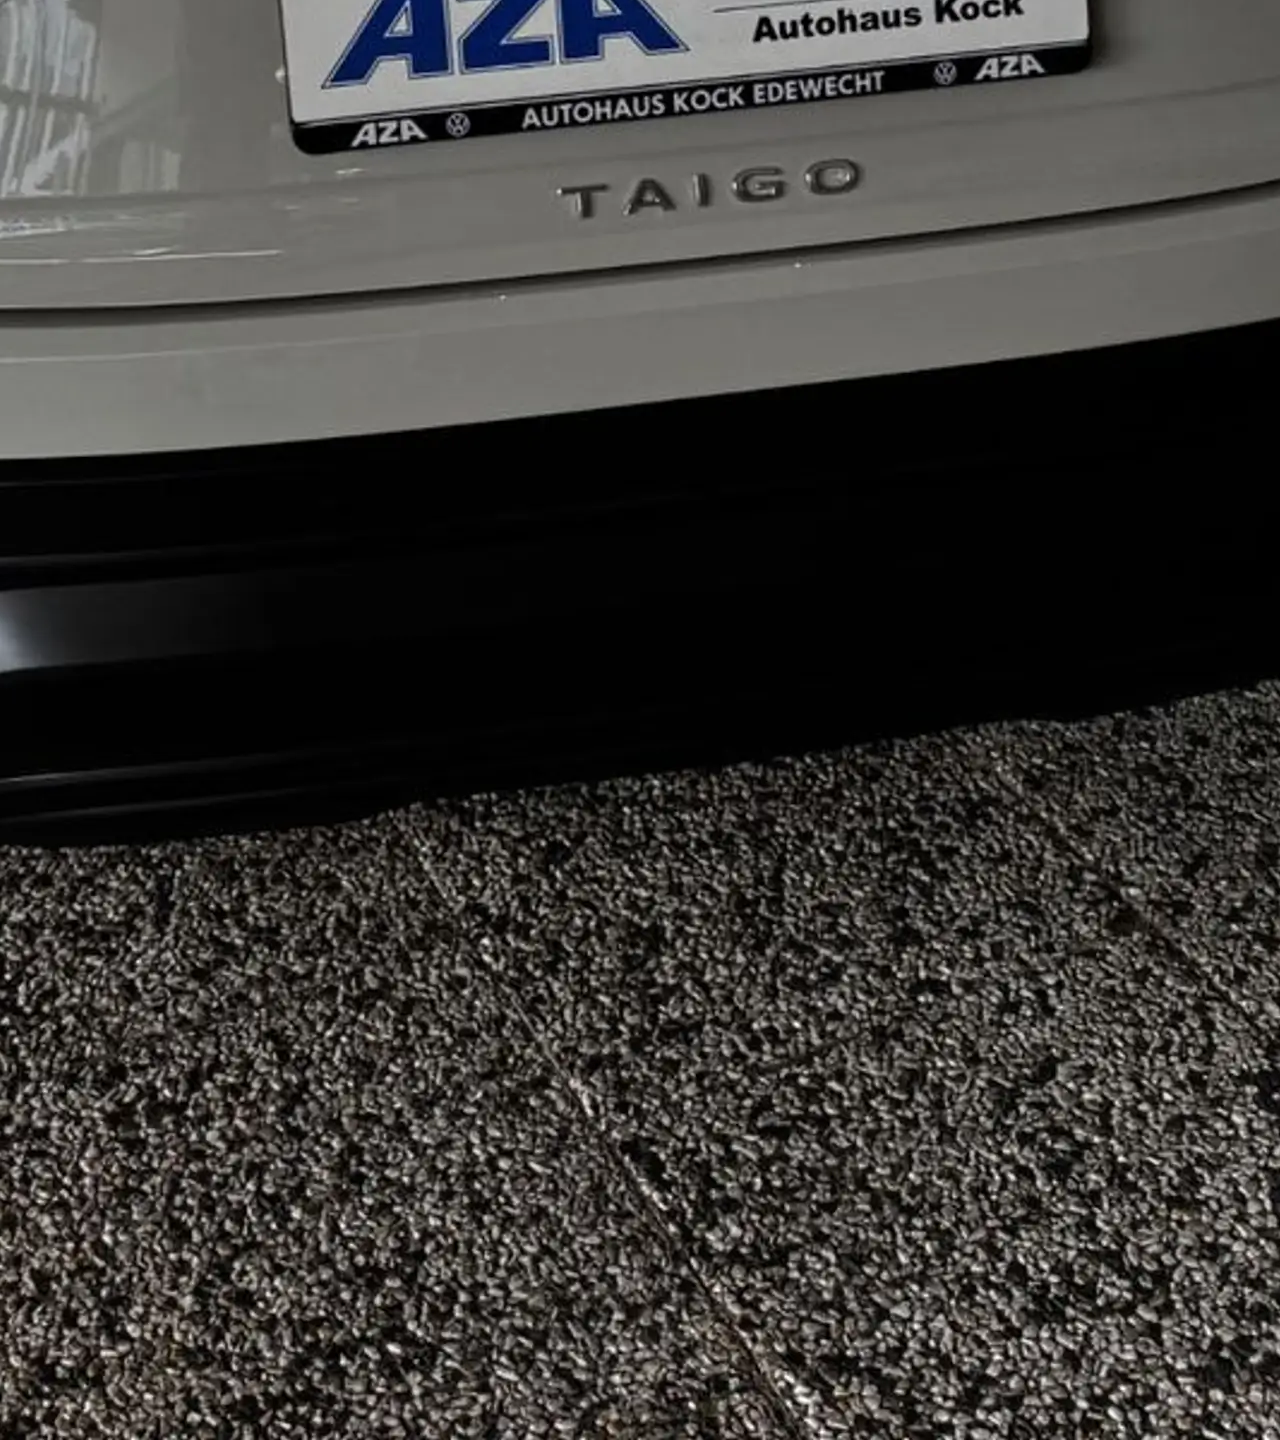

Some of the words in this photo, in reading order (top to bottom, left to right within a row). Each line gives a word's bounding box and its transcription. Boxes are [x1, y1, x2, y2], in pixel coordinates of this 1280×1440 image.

[752, 7, 922, 43] Autohaus
[350, 118, 429, 148] AZA
[521, 93, 665, 129] AUTOHAUS
[673, 85, 745, 114] KOCK
[752, 71, 886, 105] EDEWECHT
[973, 54, 1046, 81] AZA
[556, 159, 861, 219] TAIGO
